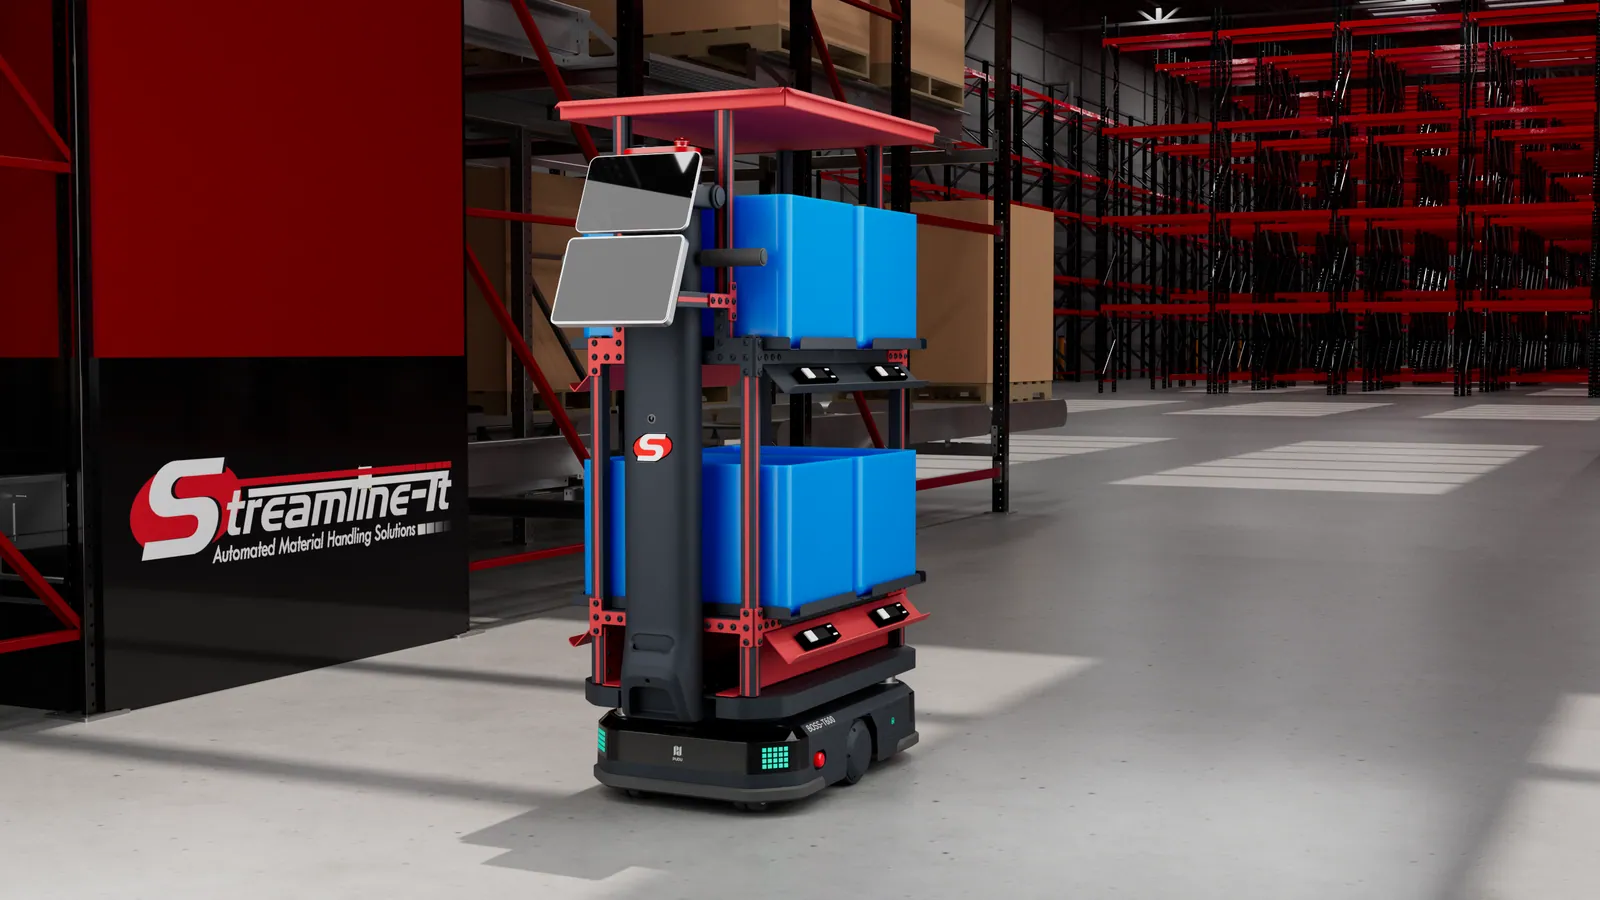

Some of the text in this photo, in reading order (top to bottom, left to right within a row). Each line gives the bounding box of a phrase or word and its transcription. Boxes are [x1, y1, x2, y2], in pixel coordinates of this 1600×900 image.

[212, 521, 416, 564] Automated Material Handling Solutions
[805, 715, 836, 733] BOSS-T600
